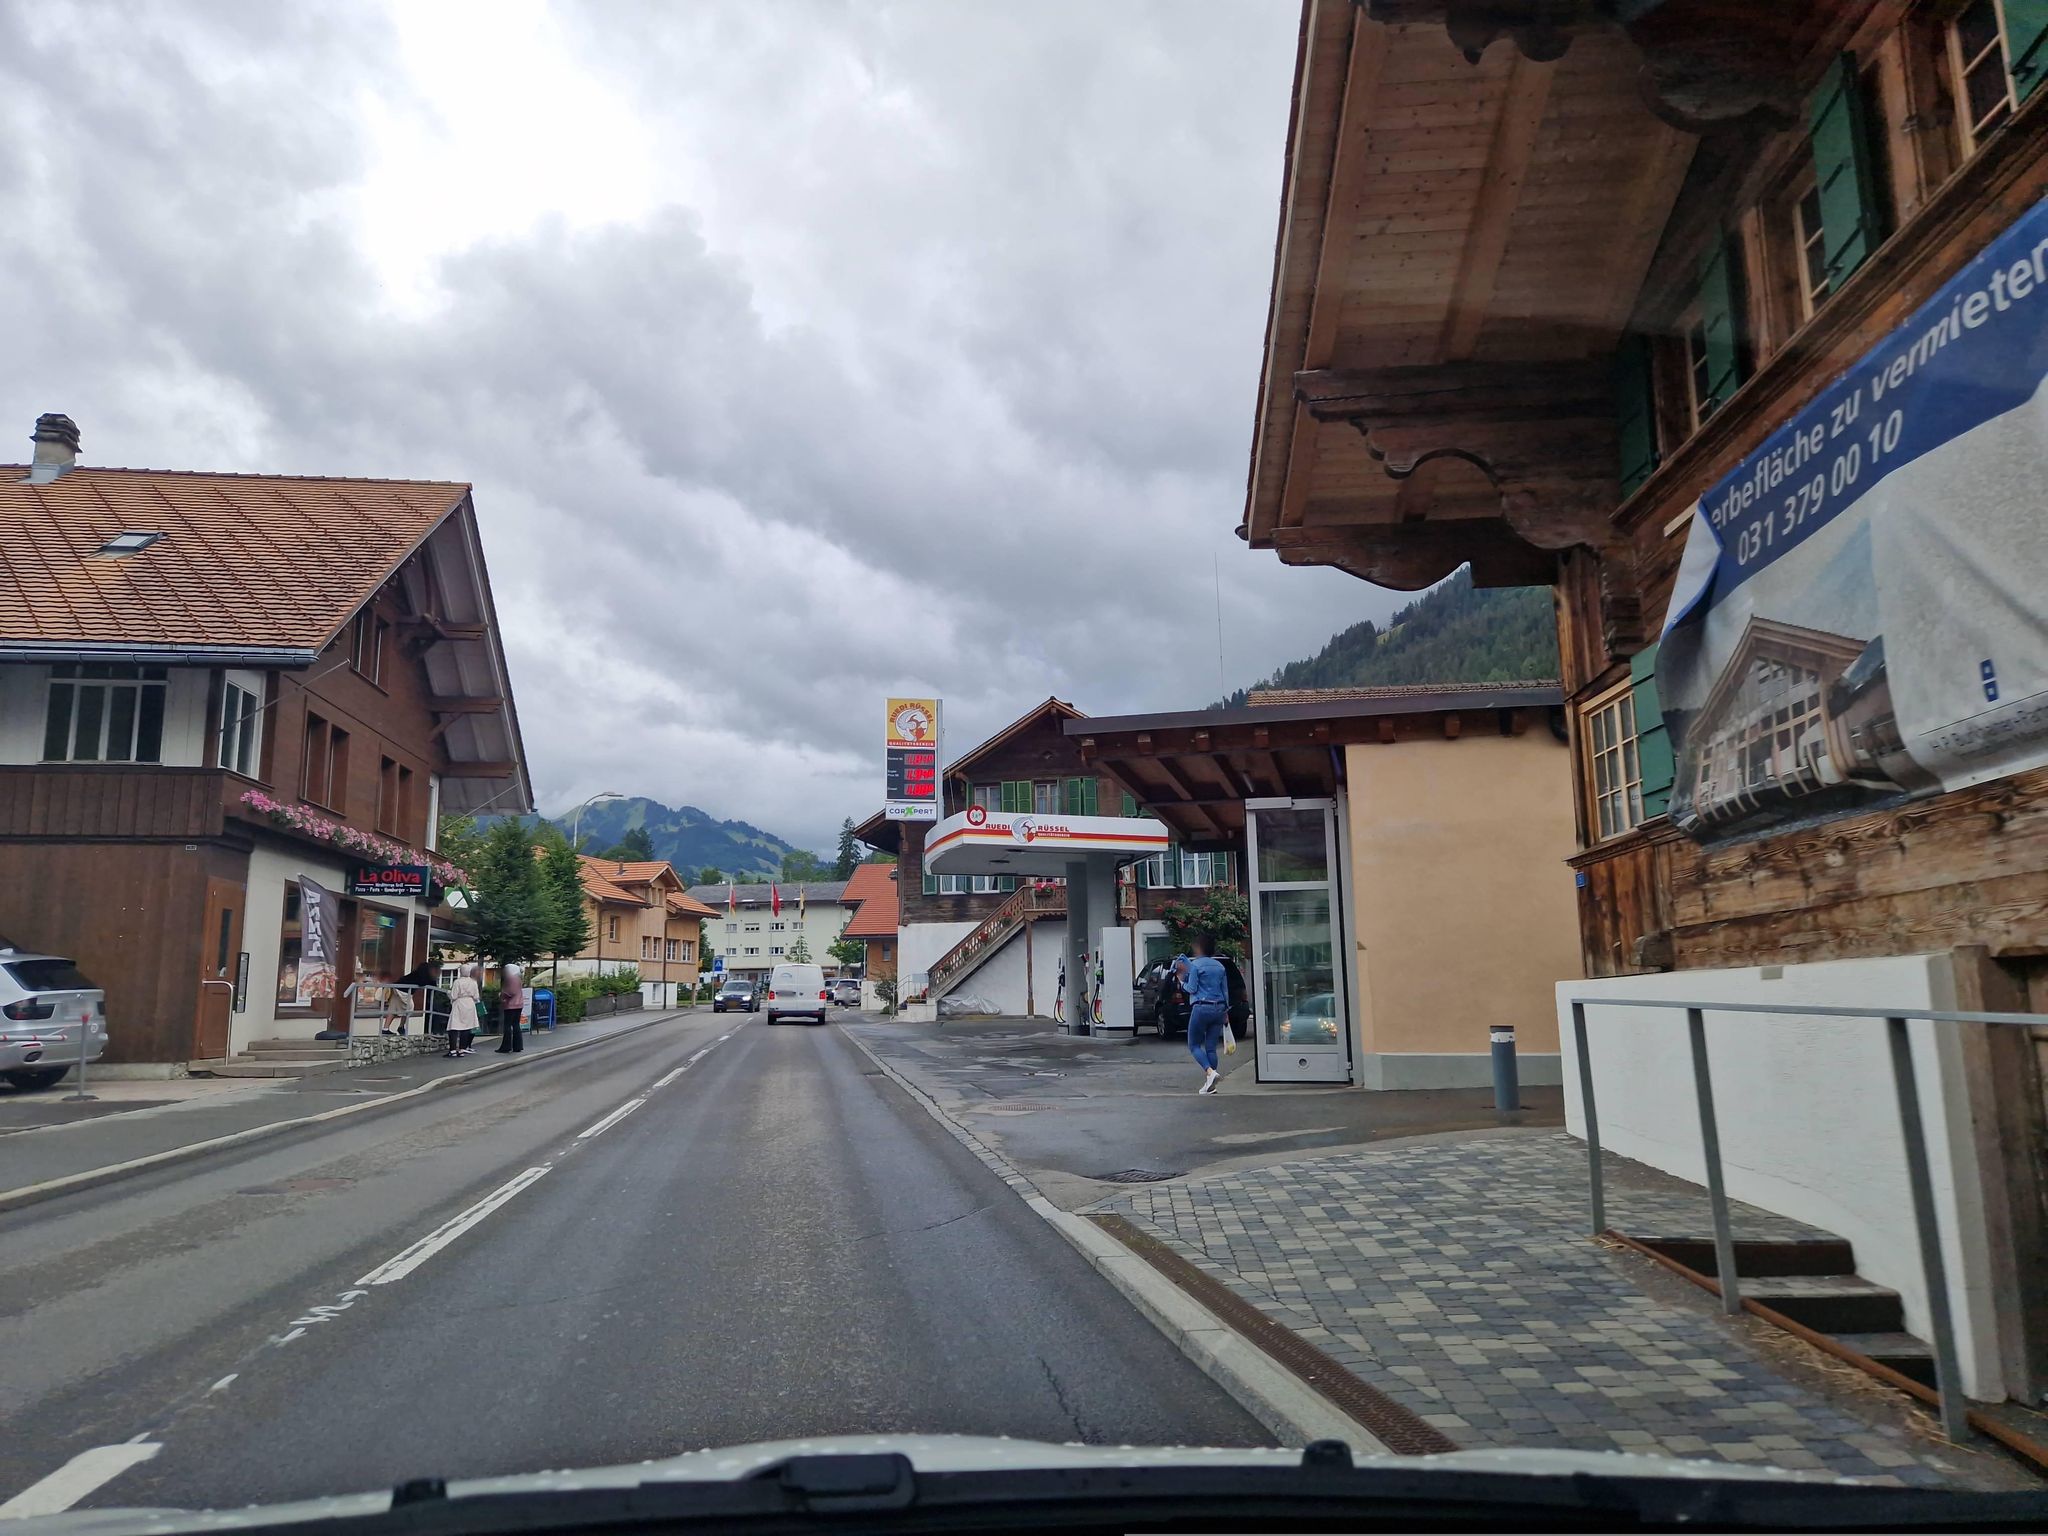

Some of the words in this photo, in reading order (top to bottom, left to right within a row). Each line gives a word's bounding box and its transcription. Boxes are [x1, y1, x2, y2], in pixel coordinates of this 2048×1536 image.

[1831, 389, 1860, 439] zu
[1738, 511, 1775, 565] 031
[1782, 474, 1825, 536] 379
[1831, 443, 1861, 497] 00
[1868, 409, 1903, 464] 10
[889, 703, 908, 723] RUEDI
[910, 702, 934, 724] RÜSSEL
[1037, 824, 1070, 833] RÜSSEL
[359, 869, 378, 883] La
[381, 869, 421, 884] Oliva
